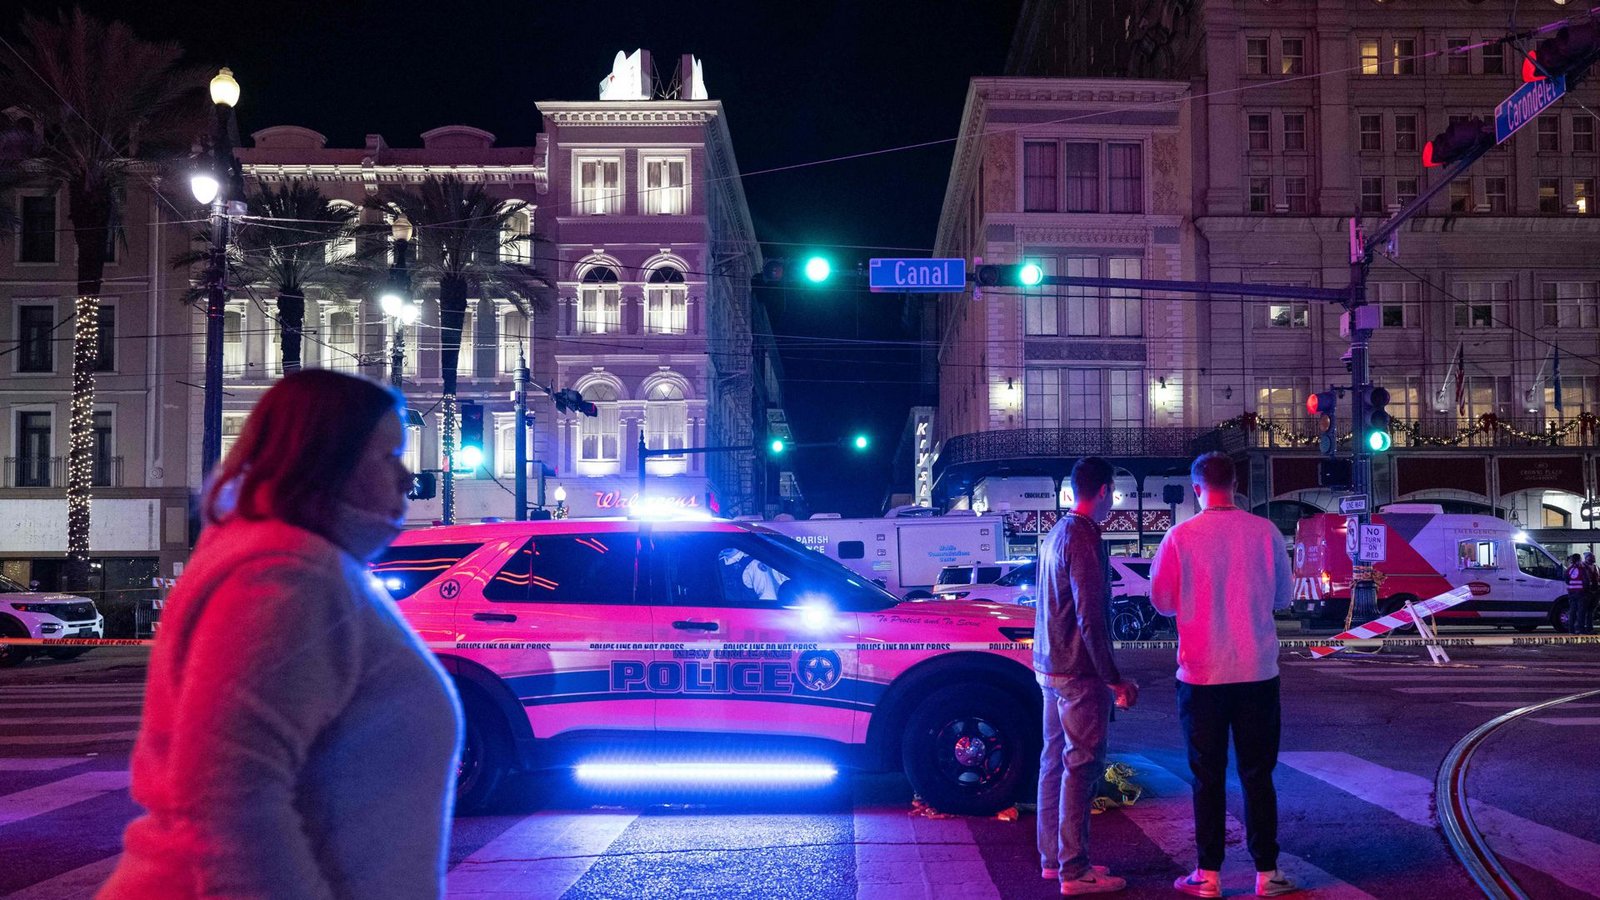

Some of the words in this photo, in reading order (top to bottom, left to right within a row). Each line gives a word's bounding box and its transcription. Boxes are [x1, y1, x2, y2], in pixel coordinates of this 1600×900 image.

[1507, 79, 1556, 130] Carondelet
[895, 261, 949, 285] Canal
[796, 535, 829, 544] PARISH
[1367, 527, 1380, 535] NO
[611, 660, 793, 694] POLICE
